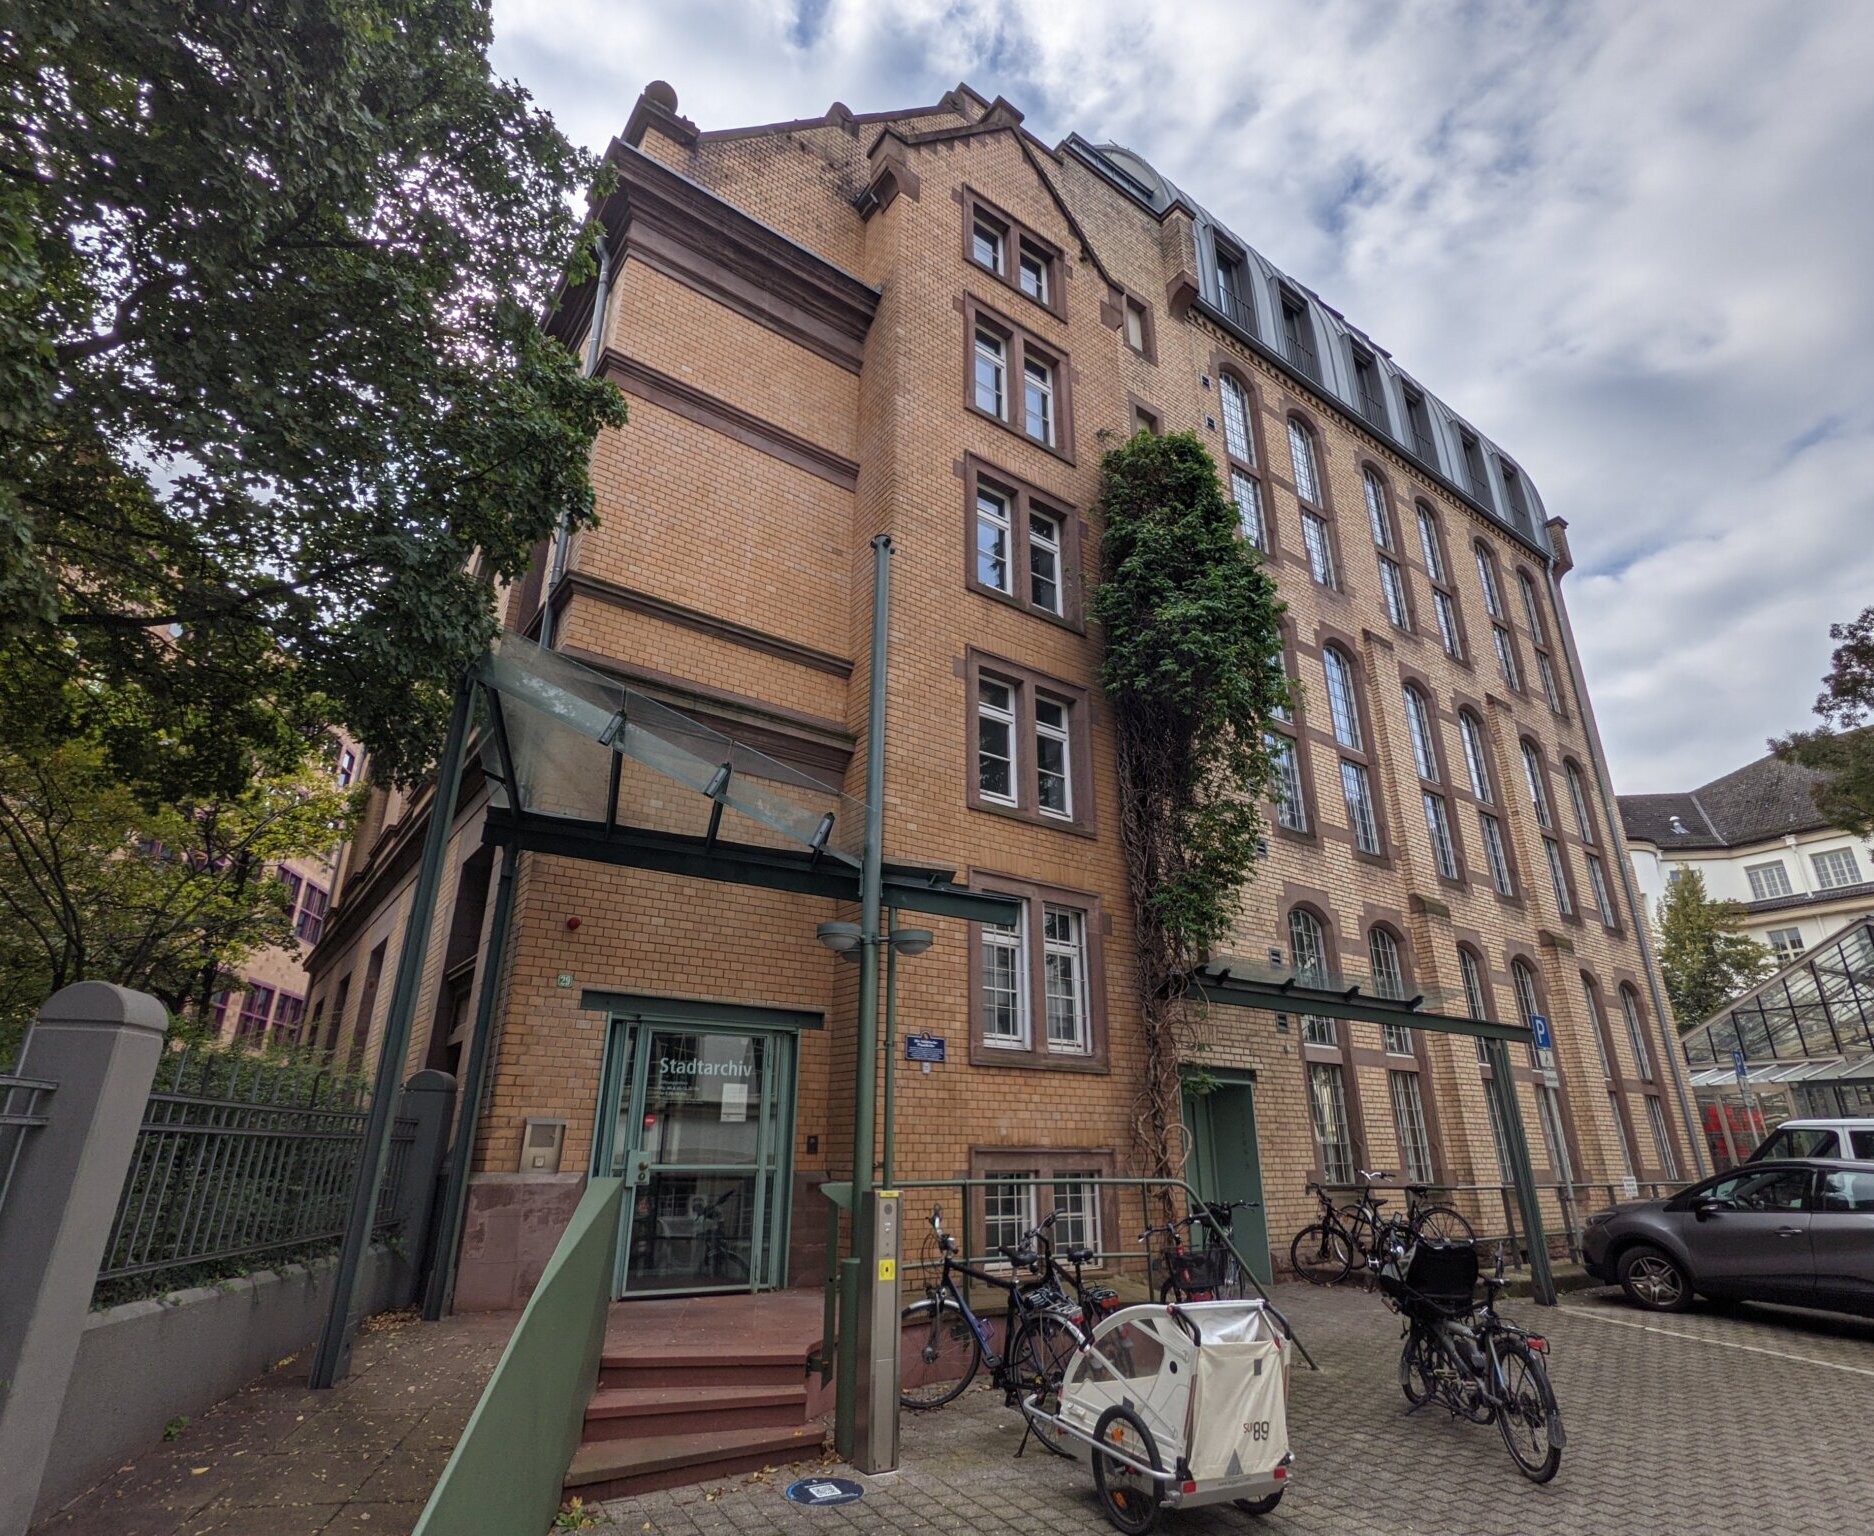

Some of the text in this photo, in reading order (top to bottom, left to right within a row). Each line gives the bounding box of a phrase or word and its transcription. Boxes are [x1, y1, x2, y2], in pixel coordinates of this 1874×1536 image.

[560, 975, 571, 986] 29
[1535, 1019, 1545, 1044] P
[660, 1057, 752, 1077] Stadtarchiv
[1735, 1053, 1742, 1073] P
[1253, 1421, 1270, 1441] 89
